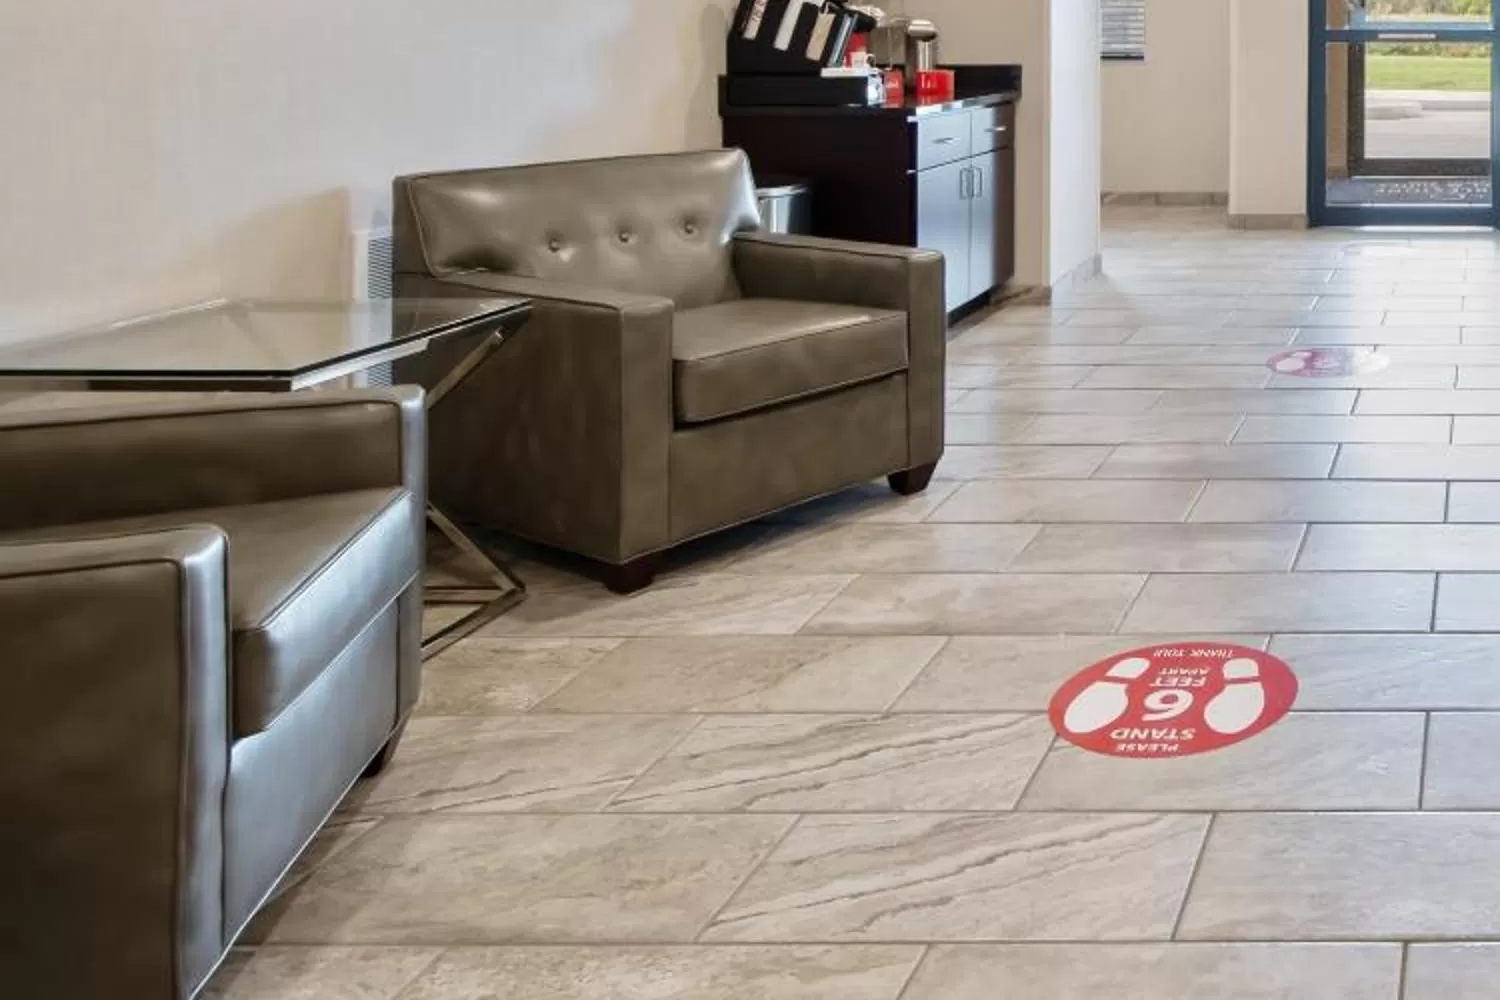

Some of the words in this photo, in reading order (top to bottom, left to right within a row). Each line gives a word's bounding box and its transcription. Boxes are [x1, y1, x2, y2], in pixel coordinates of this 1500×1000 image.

[1190, 648, 1234, 659] THANK
[1158, 667, 1211, 676] APART
[1149, 676, 1207, 687] FEET
[1141, 688, 1194, 721] 6
[1109, 727, 1197, 741] STAND
[1115, 743, 1179, 753] PLEASE
